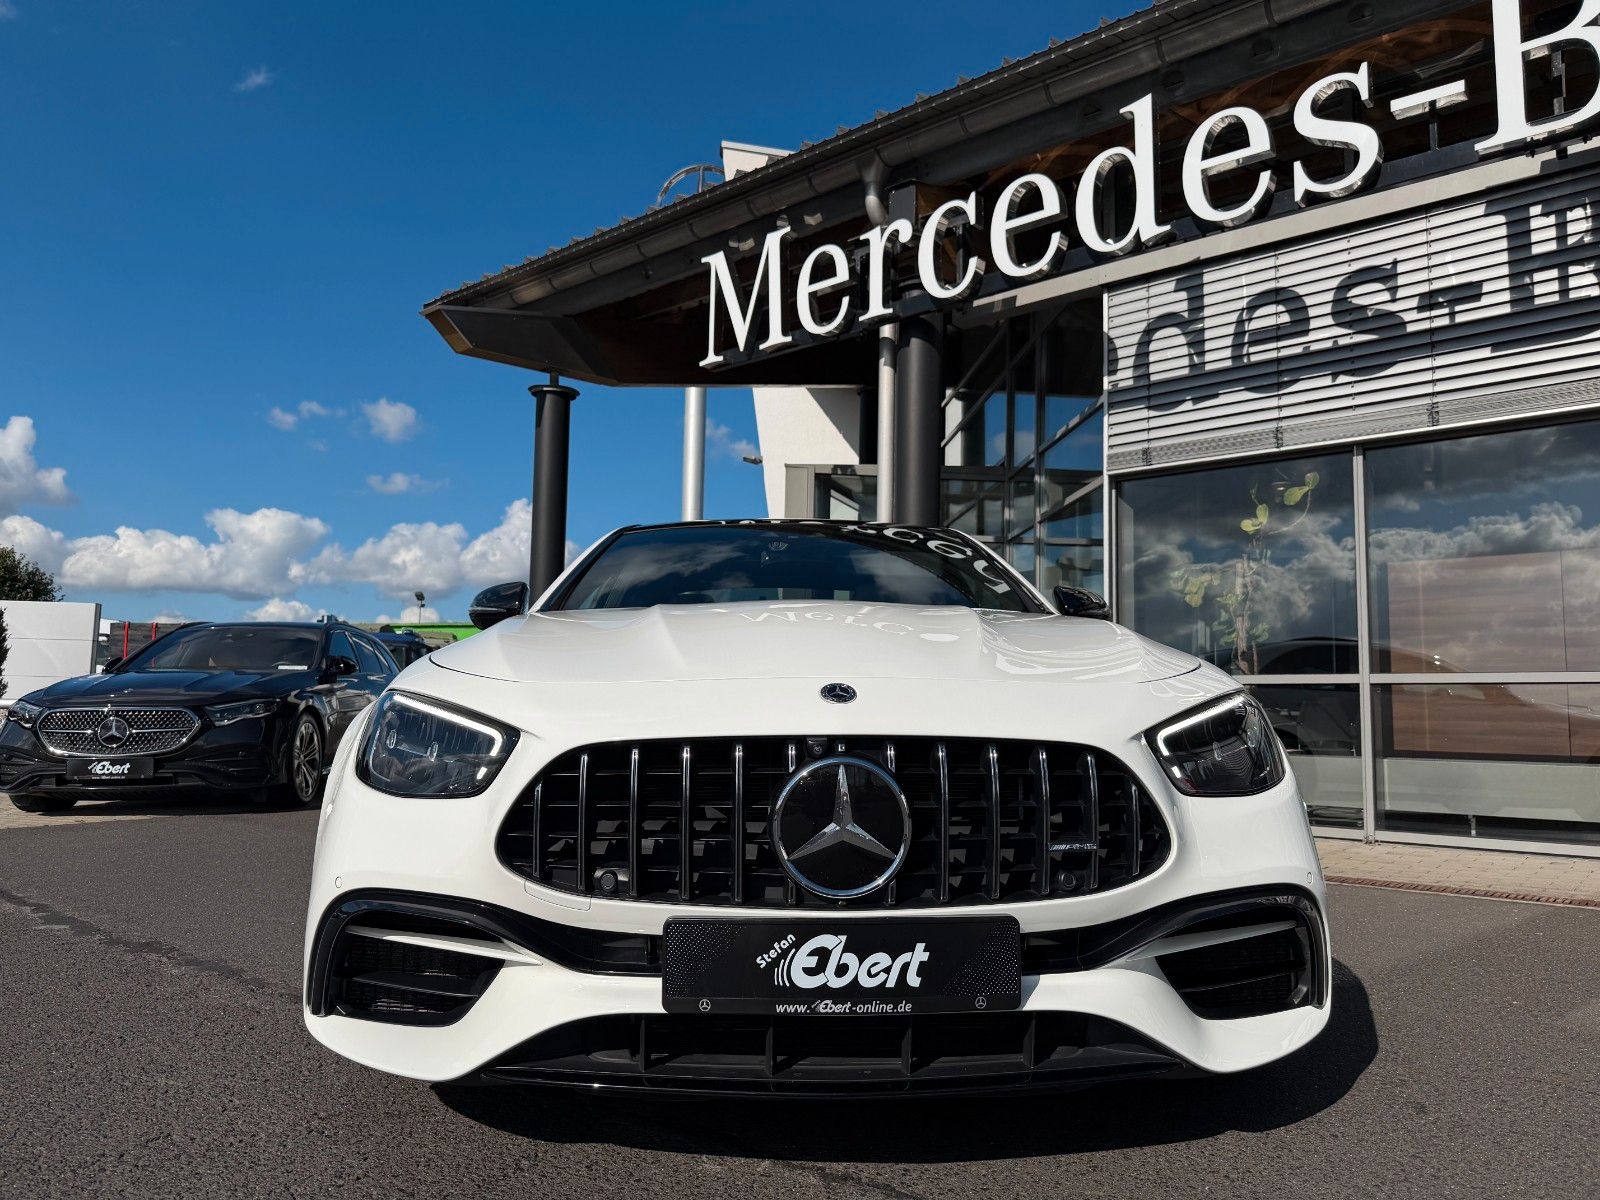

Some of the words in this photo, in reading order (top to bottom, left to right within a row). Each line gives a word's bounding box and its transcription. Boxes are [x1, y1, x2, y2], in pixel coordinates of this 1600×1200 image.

[95, 761, 131, 774] Ebert
[755, 933, 796, 969] Stefan
[790, 934, 930, 989] Ebert
[775, 999, 913, 1014] www.Ebert-online.de
